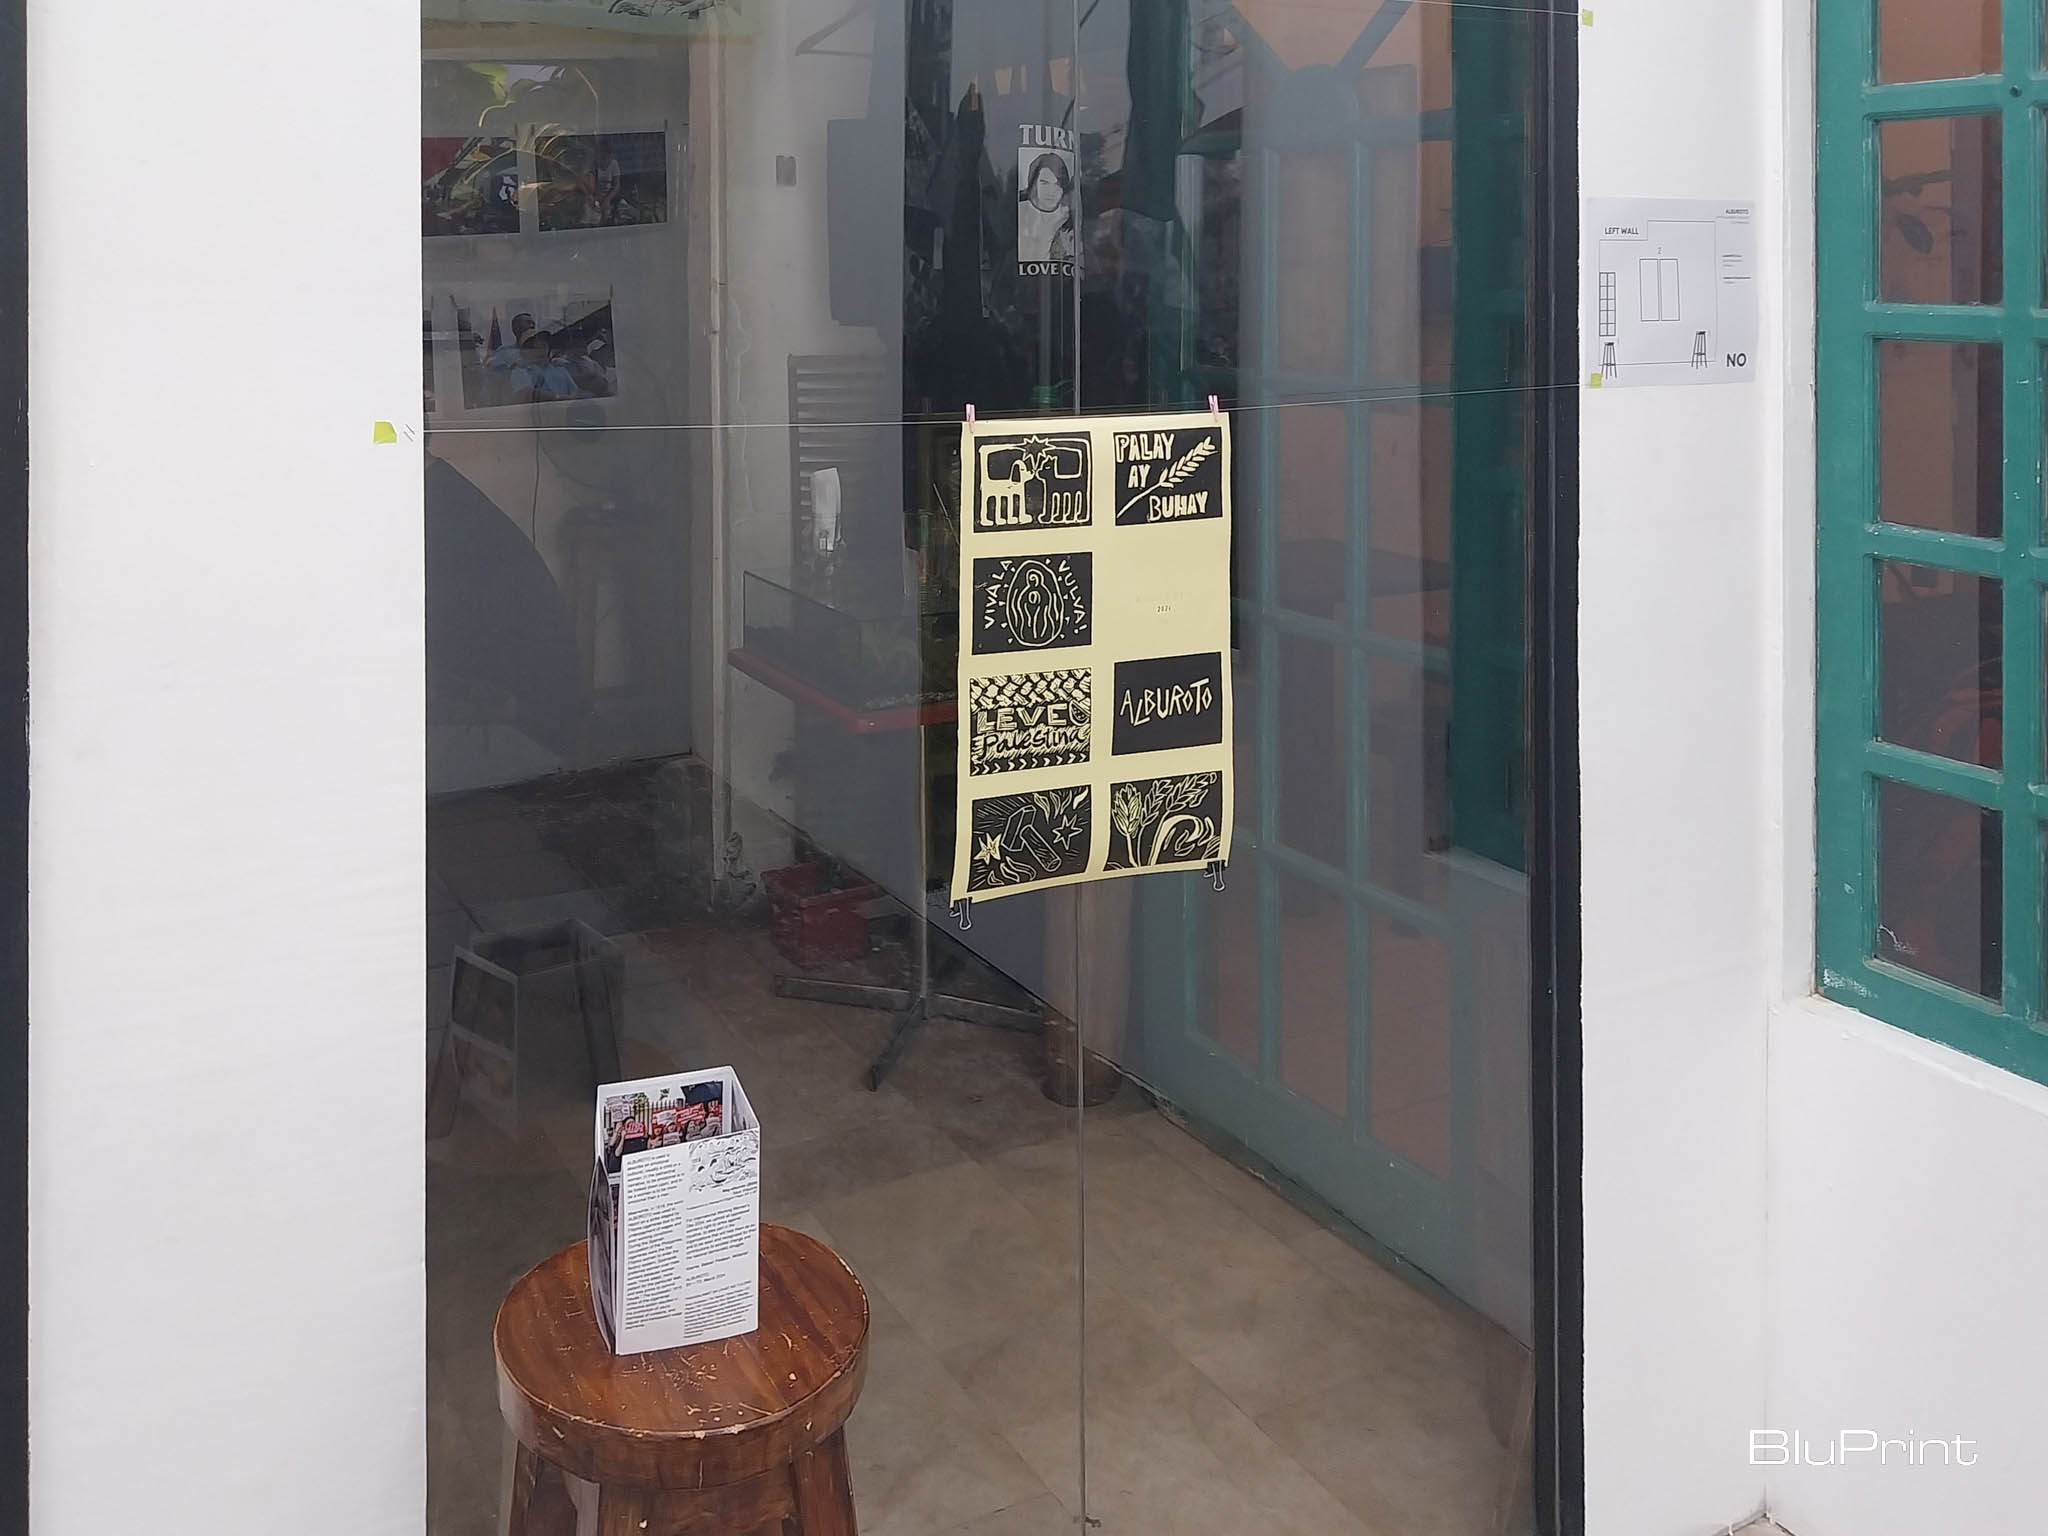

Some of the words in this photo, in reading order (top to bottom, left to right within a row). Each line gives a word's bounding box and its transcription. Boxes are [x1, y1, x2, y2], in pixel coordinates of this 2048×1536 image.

[1604, 227, 1620, 235] LEFT
[1621, 227, 1639, 235] WALL
[1019, 263, 1059, 276] LOVE
[1726, 353, 1747, 367] NO
[1115, 433, 1175, 463] PALAY
[1128, 464, 1150, 488] AY
[1149, 491, 1208, 522] BUHAY
[992, 560, 1013, 580] LA
[984, 584, 1001, 629] VIVA
[1059, 559, 1088, 634] VULVA!
[1120, 678, 1212, 726] ALBUROTO
[976, 703, 1068, 734] LEVE
